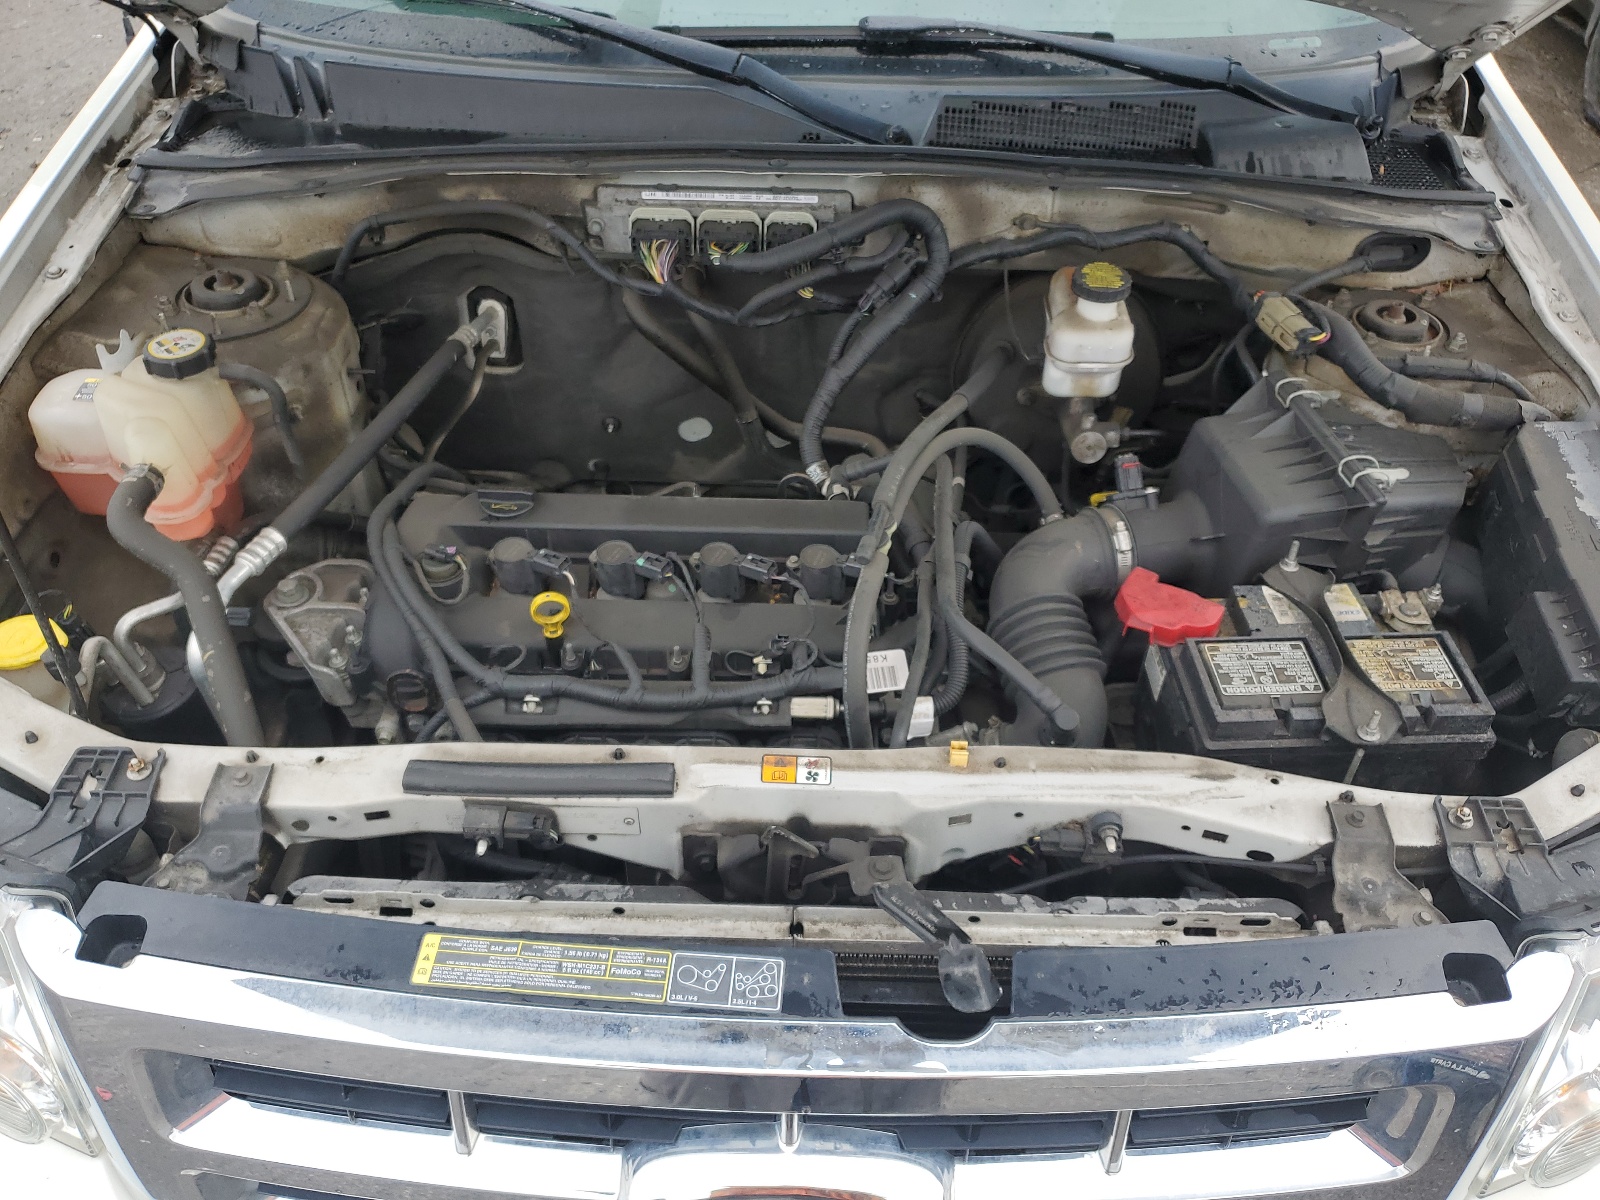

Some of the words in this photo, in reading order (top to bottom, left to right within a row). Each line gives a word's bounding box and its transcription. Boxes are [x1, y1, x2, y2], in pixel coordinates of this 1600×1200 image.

[1226, 685, 1302, 693] DANGER/POISON
[489, 944, 503, 952] SAE
[646, 956, 667, 964] R-134A
[611, 967, 642, 975] FoMoCo
